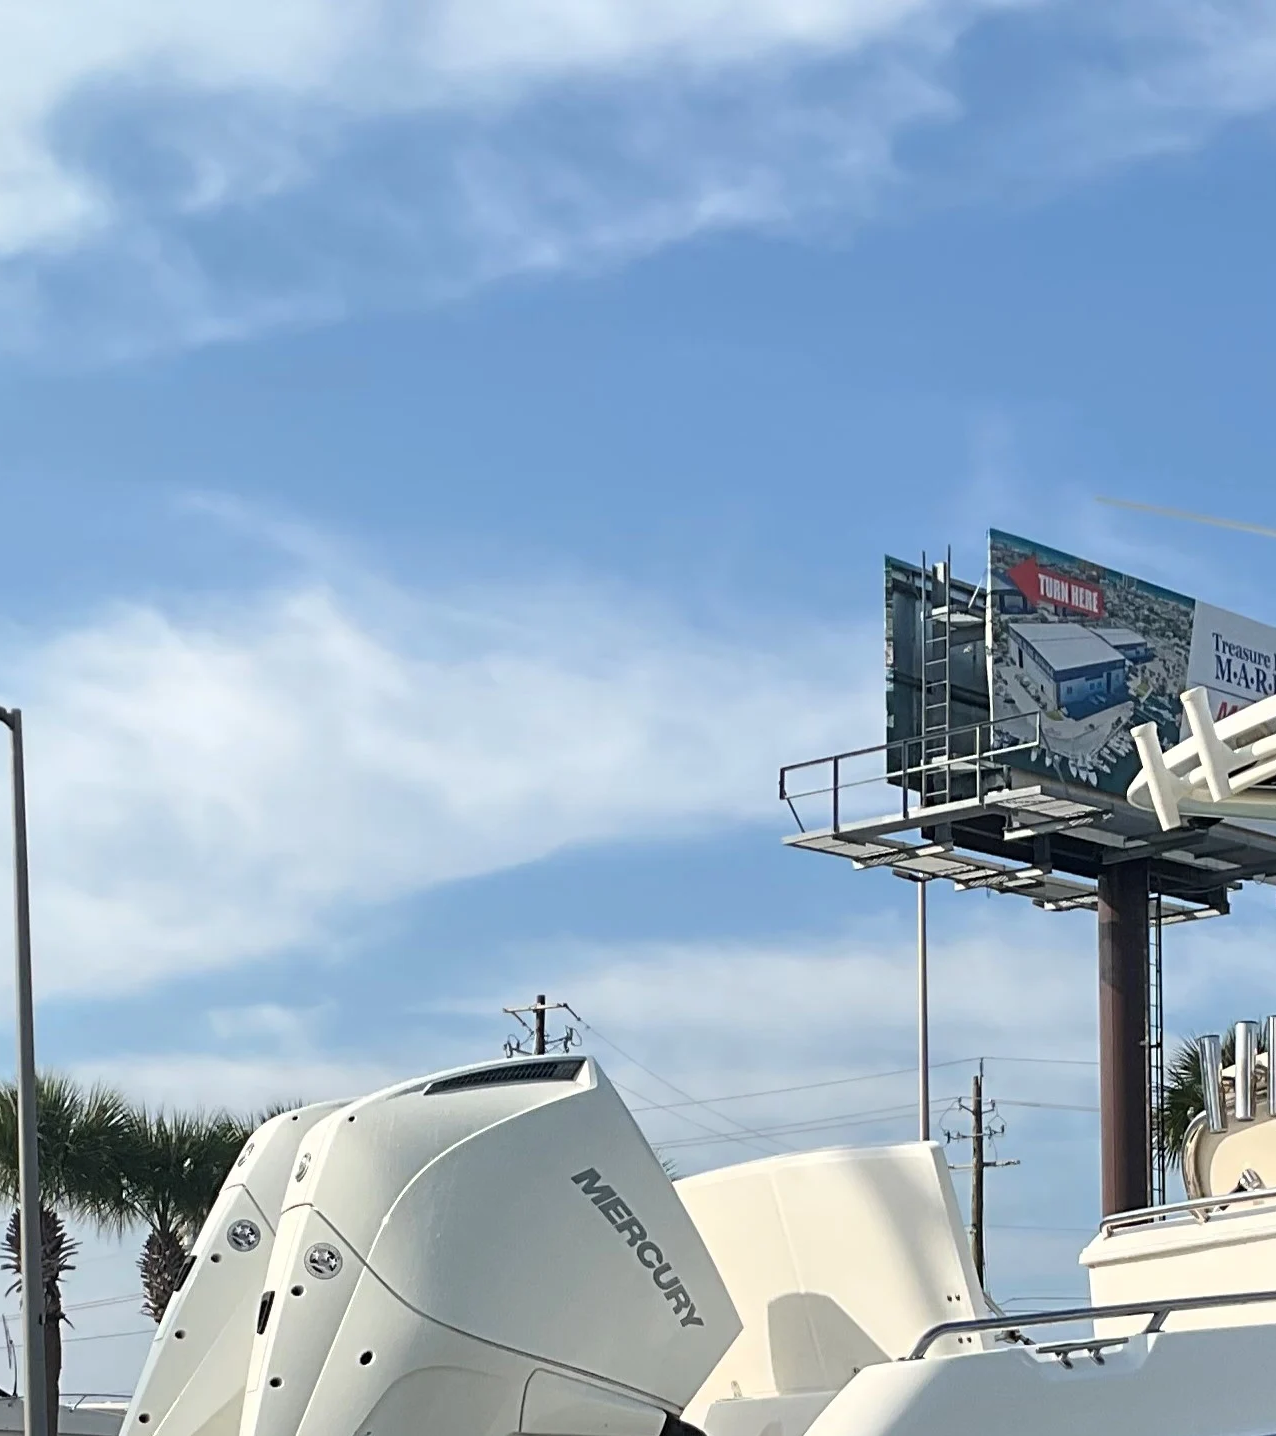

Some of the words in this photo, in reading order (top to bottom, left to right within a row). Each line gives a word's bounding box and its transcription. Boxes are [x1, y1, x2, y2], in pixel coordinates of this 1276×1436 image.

[1038, 573, 1069, 604] TURN
[1070, 584, 1099, 614] HERE
[1212, 632, 1271, 669] Treasure
[570, 1167, 705, 1328] MERCURY
